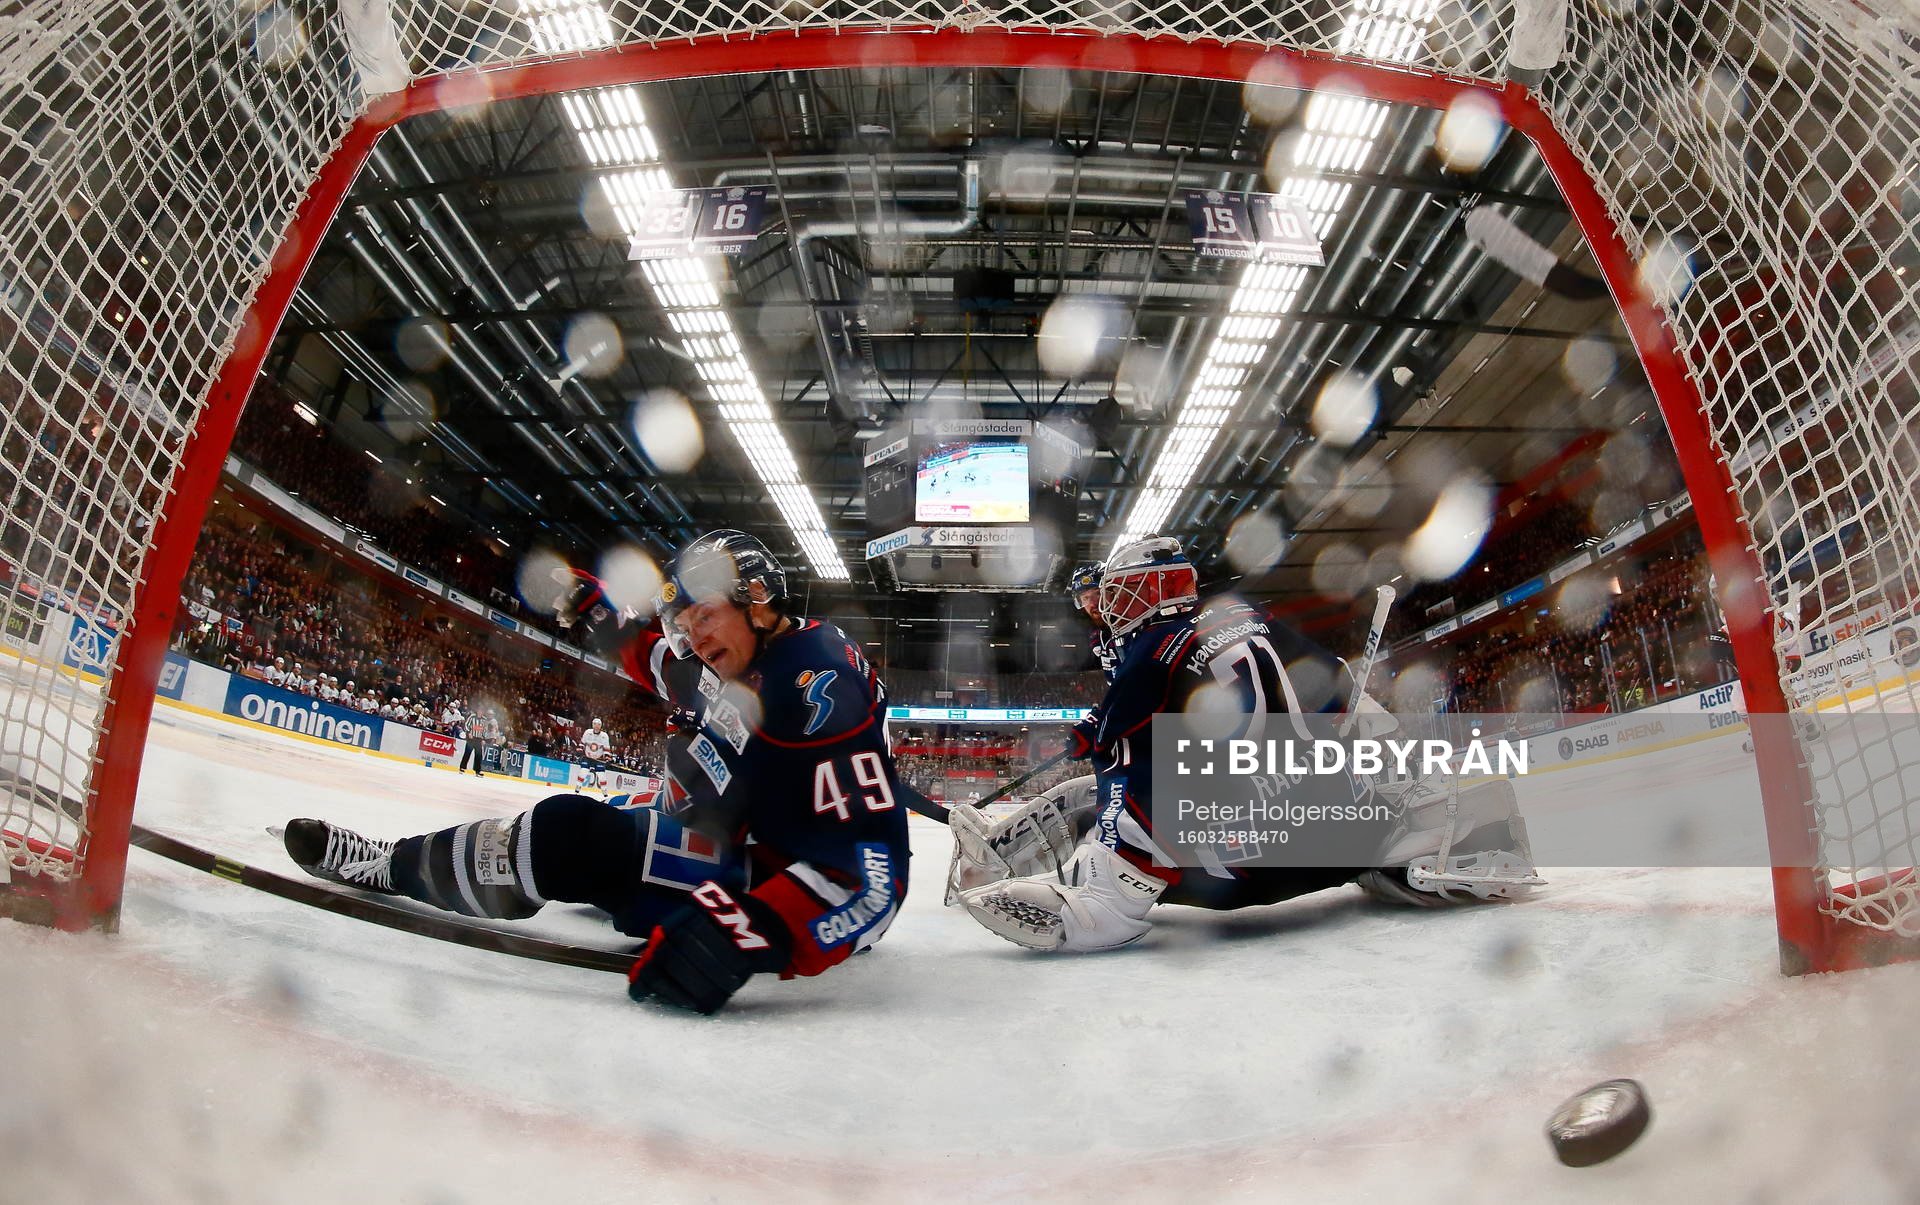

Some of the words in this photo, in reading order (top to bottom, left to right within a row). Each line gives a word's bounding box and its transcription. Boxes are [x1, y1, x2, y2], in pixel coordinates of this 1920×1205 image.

[713, 203, 748, 231] 16
[1203, 206, 1237, 233] 15
[1268, 211, 1300, 238] 10
[868, 534, 909, 557] Corren
[1190, 609, 1214, 624] CCM
[240, 693, 372, 748] onninen
[423, 737, 452, 751] CCM
[1575, 733, 1610, 752] SAAB
[1616, 720, 1666, 744] ARENA
[814, 751, 896, 820] 49
[1119, 872, 1158, 896] CCM
